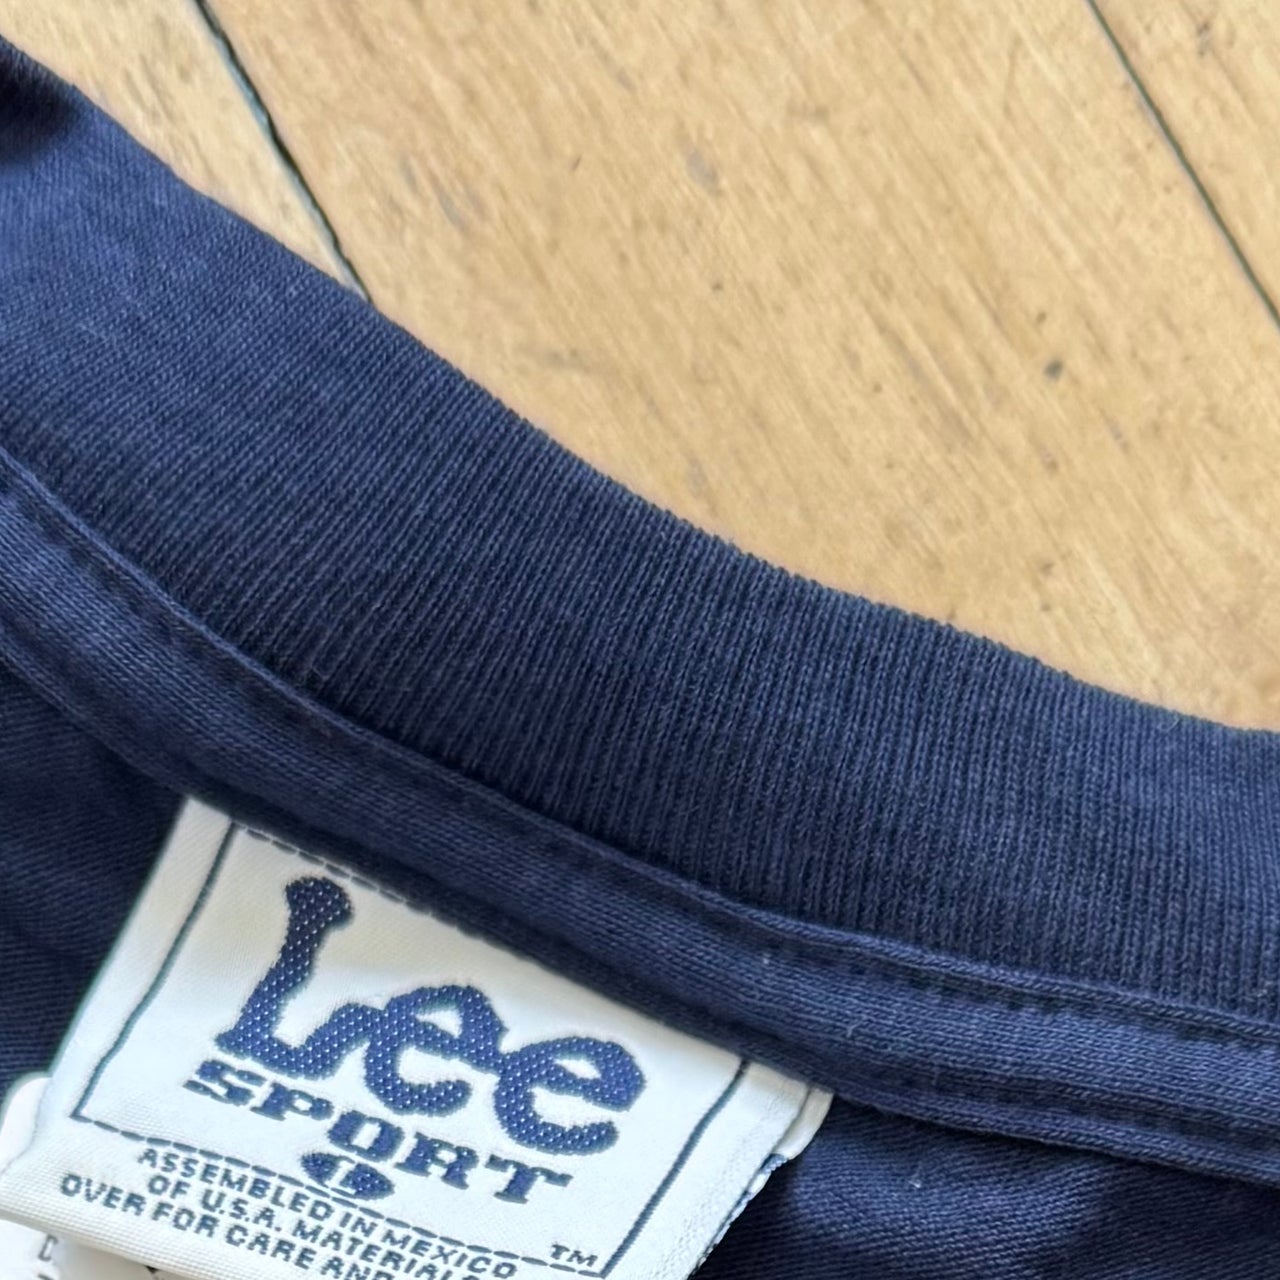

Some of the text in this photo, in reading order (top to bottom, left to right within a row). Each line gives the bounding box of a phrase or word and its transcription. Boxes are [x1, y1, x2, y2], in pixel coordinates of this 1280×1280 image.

[215, 877, 646, 1155] Lee
[183, 1058, 573, 1205] SPORT
[59, 1173, 146, 1217] OVER
[150, 1200, 218, 1240] FOR
[225, 1220, 317, 1271] CARE
[137, 1147, 518, 1279] ASSEMBLED IN MEXICO
[148, 1174, 191, 1205] OF
[202, 1187, 282, 1234] U.S.A.
